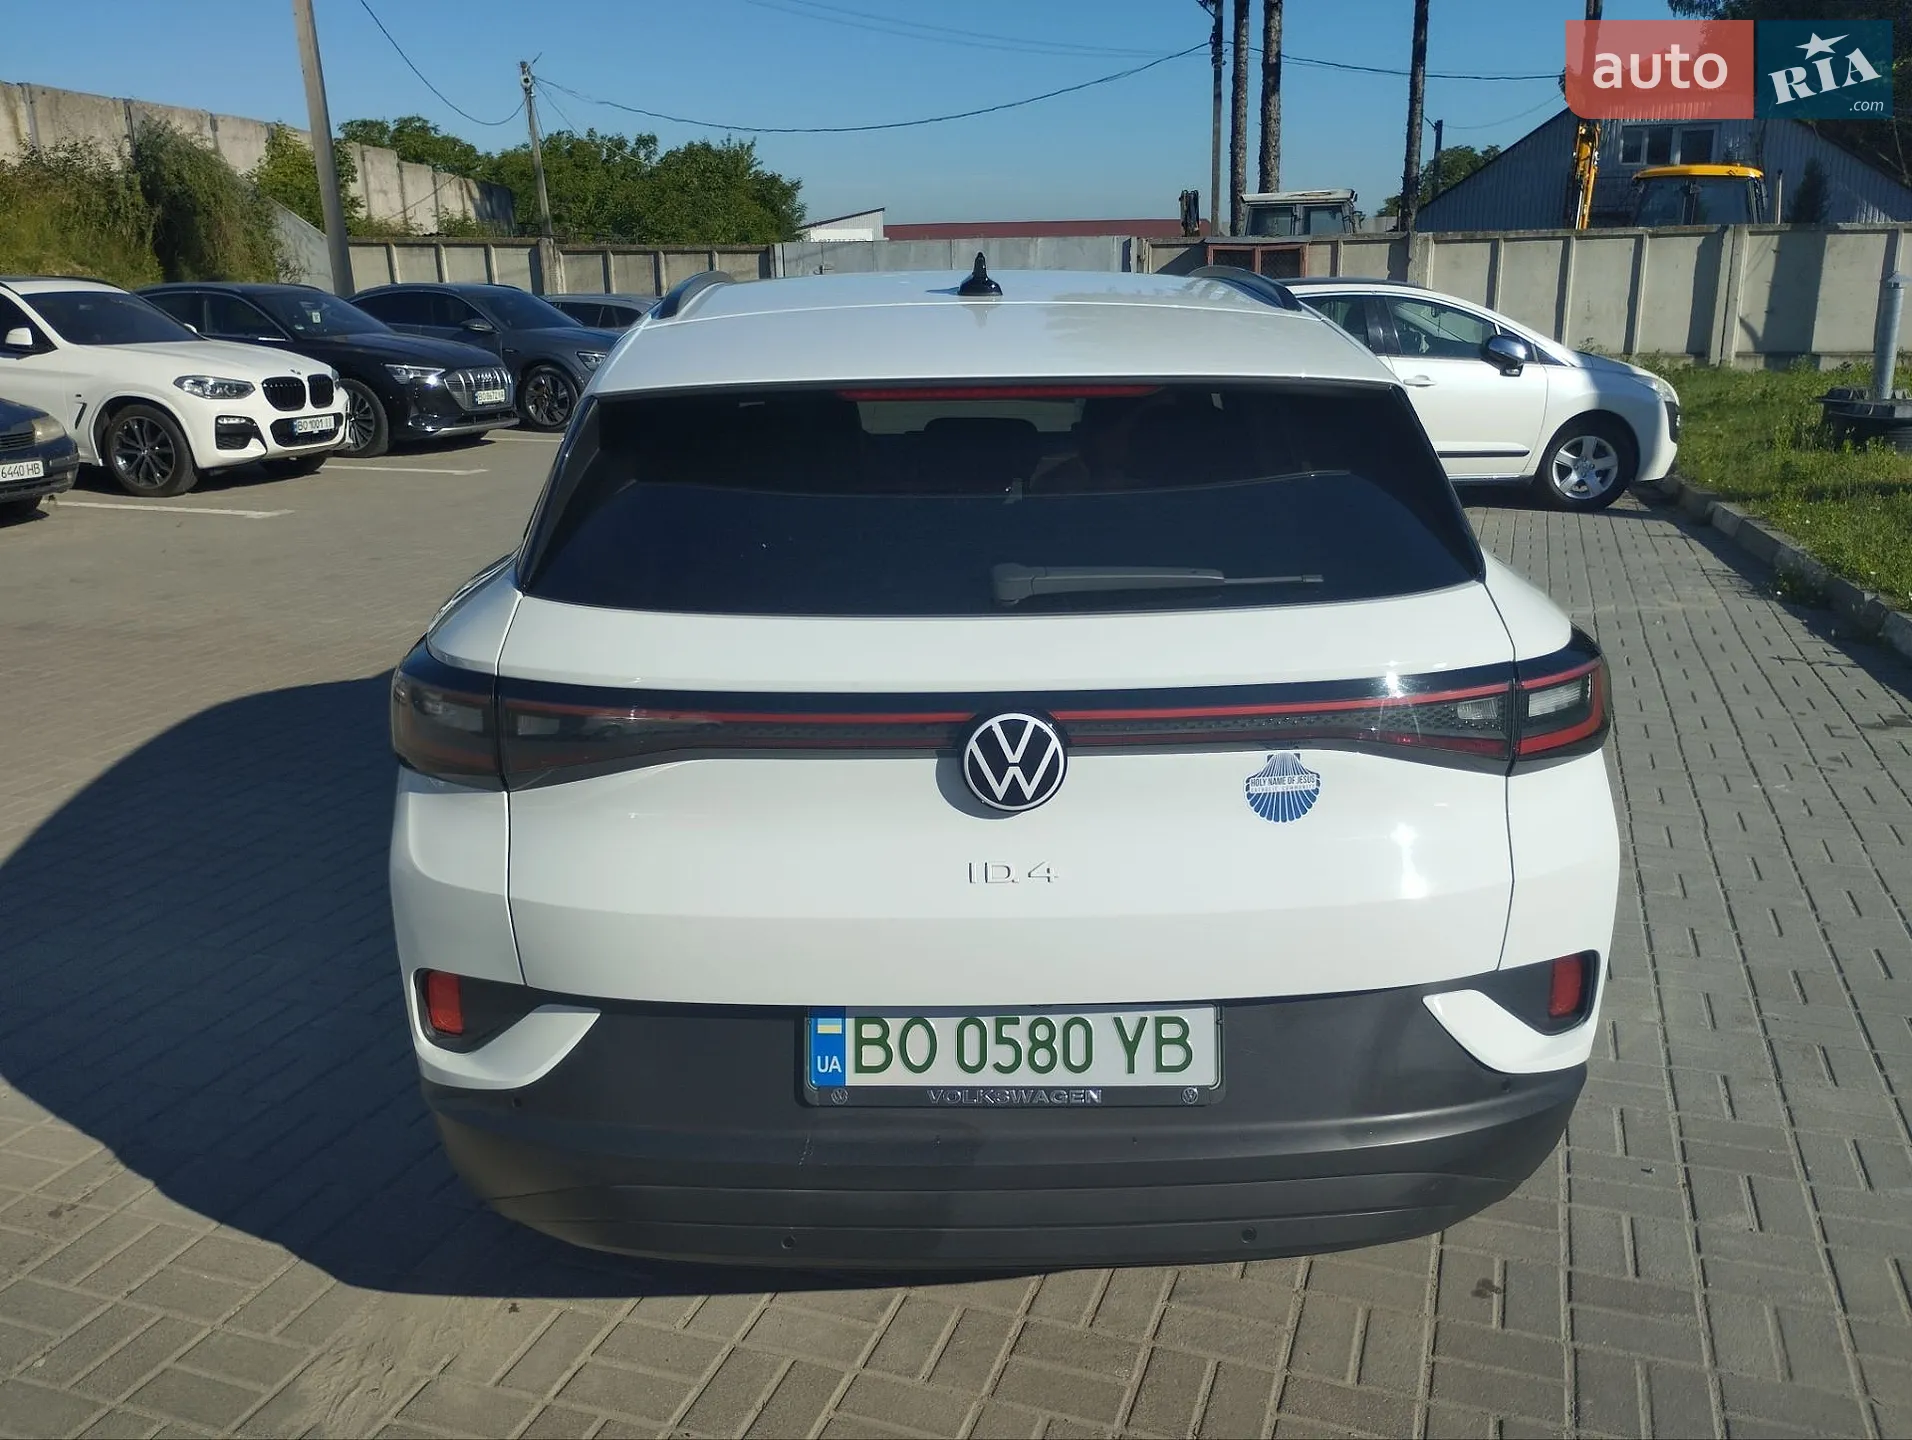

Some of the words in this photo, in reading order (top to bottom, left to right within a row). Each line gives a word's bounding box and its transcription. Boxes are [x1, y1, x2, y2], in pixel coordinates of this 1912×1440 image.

[297, 420, 308, 431] BO
[309, 418, 323, 429] 1001
[1, 464, 25, 478] 6440
[26, 462, 41, 476] HB
[965, 713, 1065, 811] VW
[1251, 778, 1267, 787] HOLY
[1268, 776, 1286, 786] NAME
[1287, 775, 1296, 785] OF
[1297, 774, 1315, 784] JESUS
[854, 1015, 938, 1074] BO
[956, 1015, 1094, 1074] 0580
[1112, 1015, 1194, 1074] YB
[816, 1055, 842, 1073] UA
[926, 1089, 1103, 1104] VOLKSWAGEN
